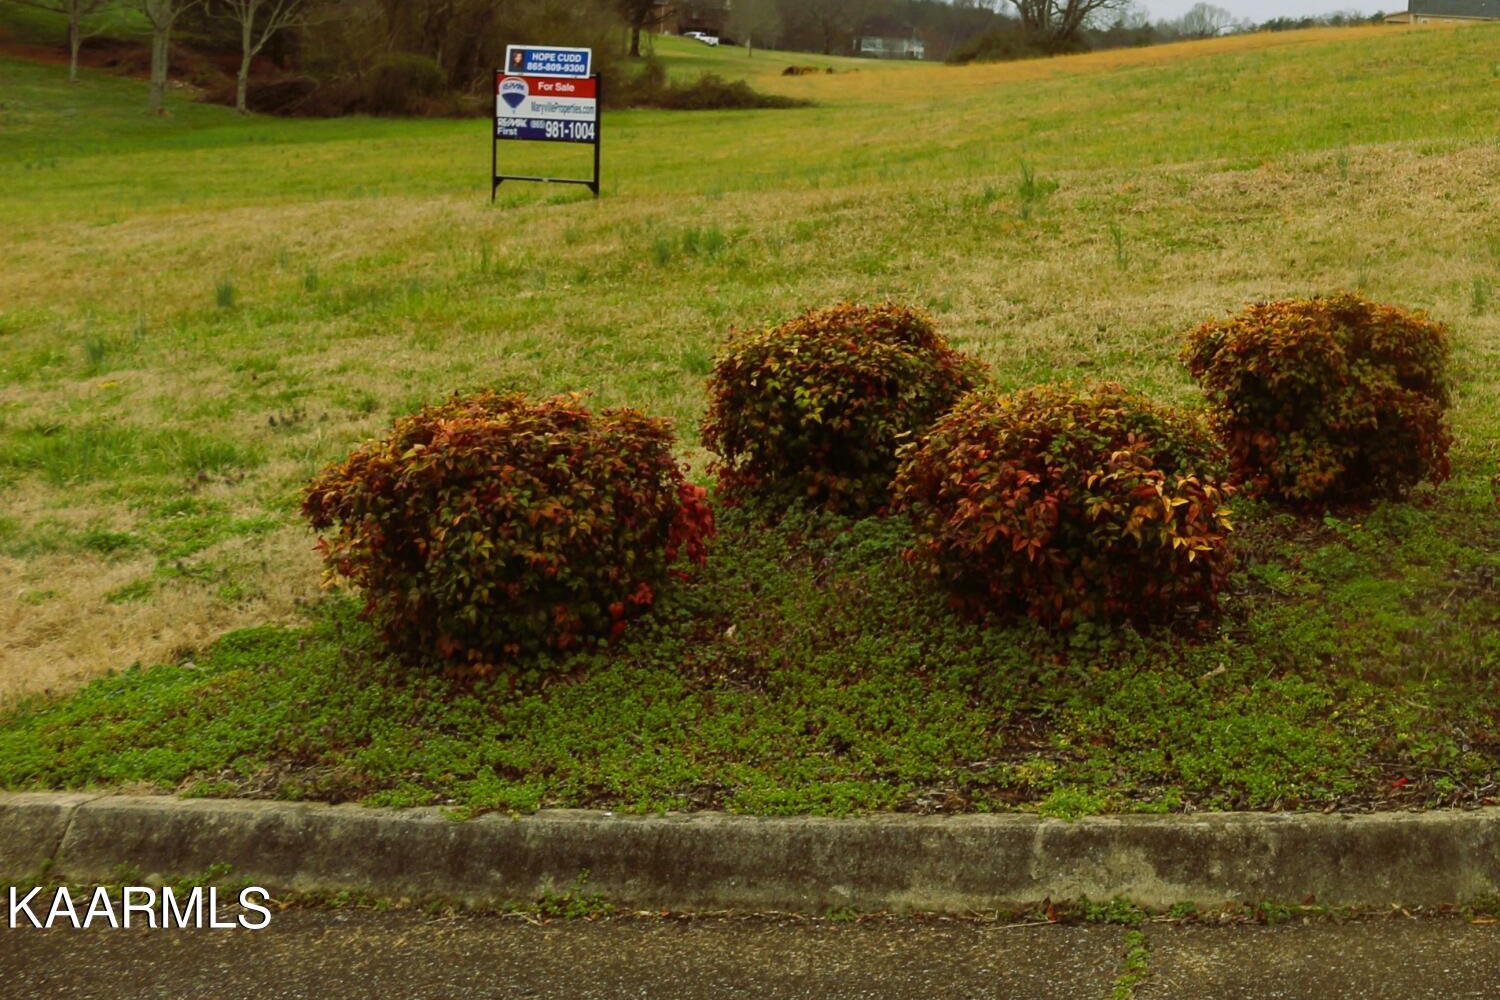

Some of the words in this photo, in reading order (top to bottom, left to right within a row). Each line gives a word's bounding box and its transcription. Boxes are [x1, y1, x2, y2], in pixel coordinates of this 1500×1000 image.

[532, 52, 556, 61] HOPE
[557, 53, 582, 63] CUDD
[538, 81, 553, 91] For
[555, 82, 575, 92] Sale
[497, 127, 518, 136] First
[545, 121, 595, 139] 981-1004
